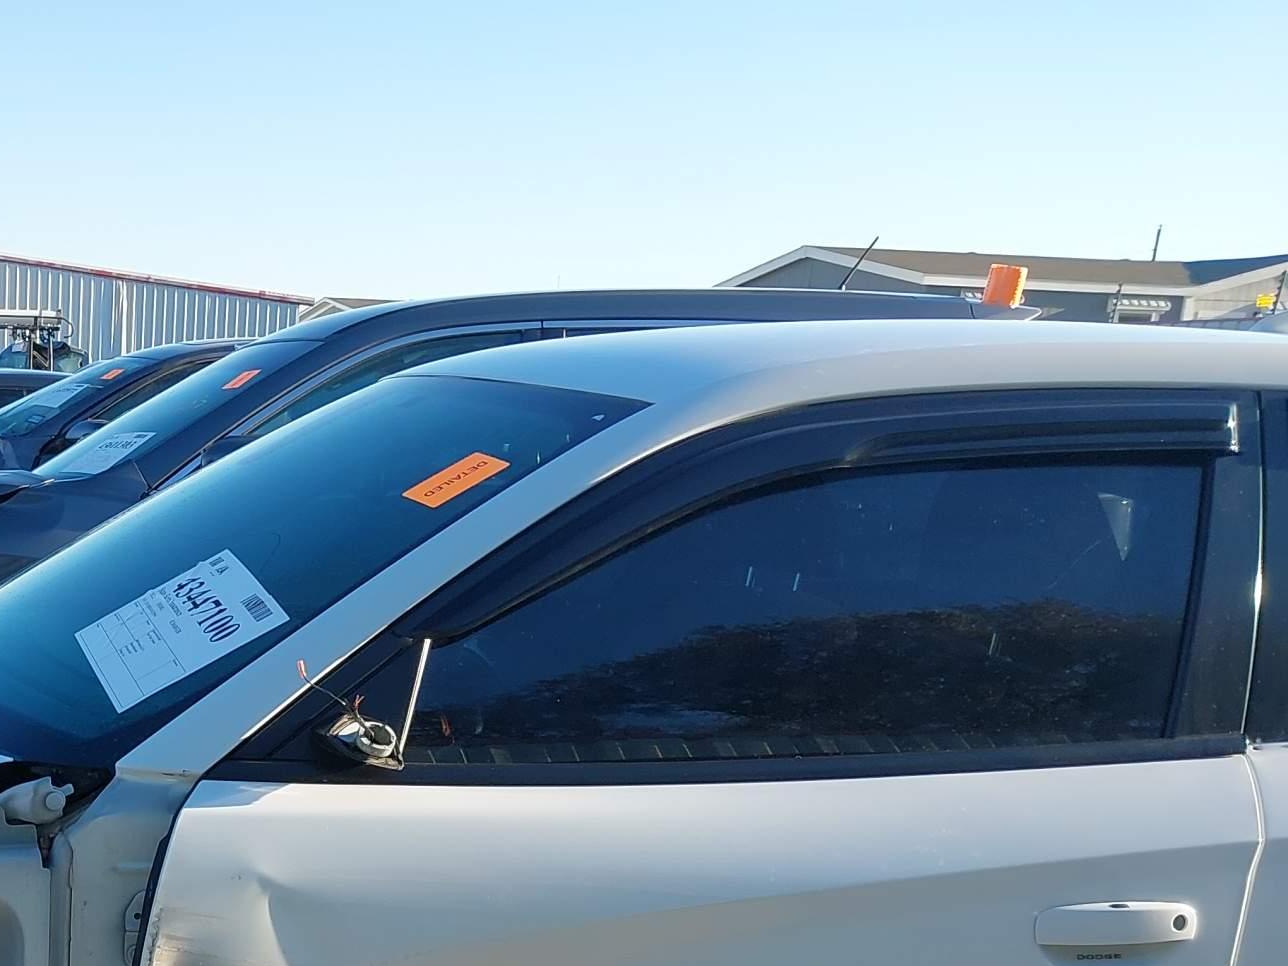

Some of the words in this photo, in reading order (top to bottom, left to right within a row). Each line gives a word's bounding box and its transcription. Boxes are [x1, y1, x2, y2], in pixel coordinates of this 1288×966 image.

[423, 460, 489, 497] DETAILED
[172, 576, 241, 643] 43447100
[1075, 952, 1123, 961] DODGE
